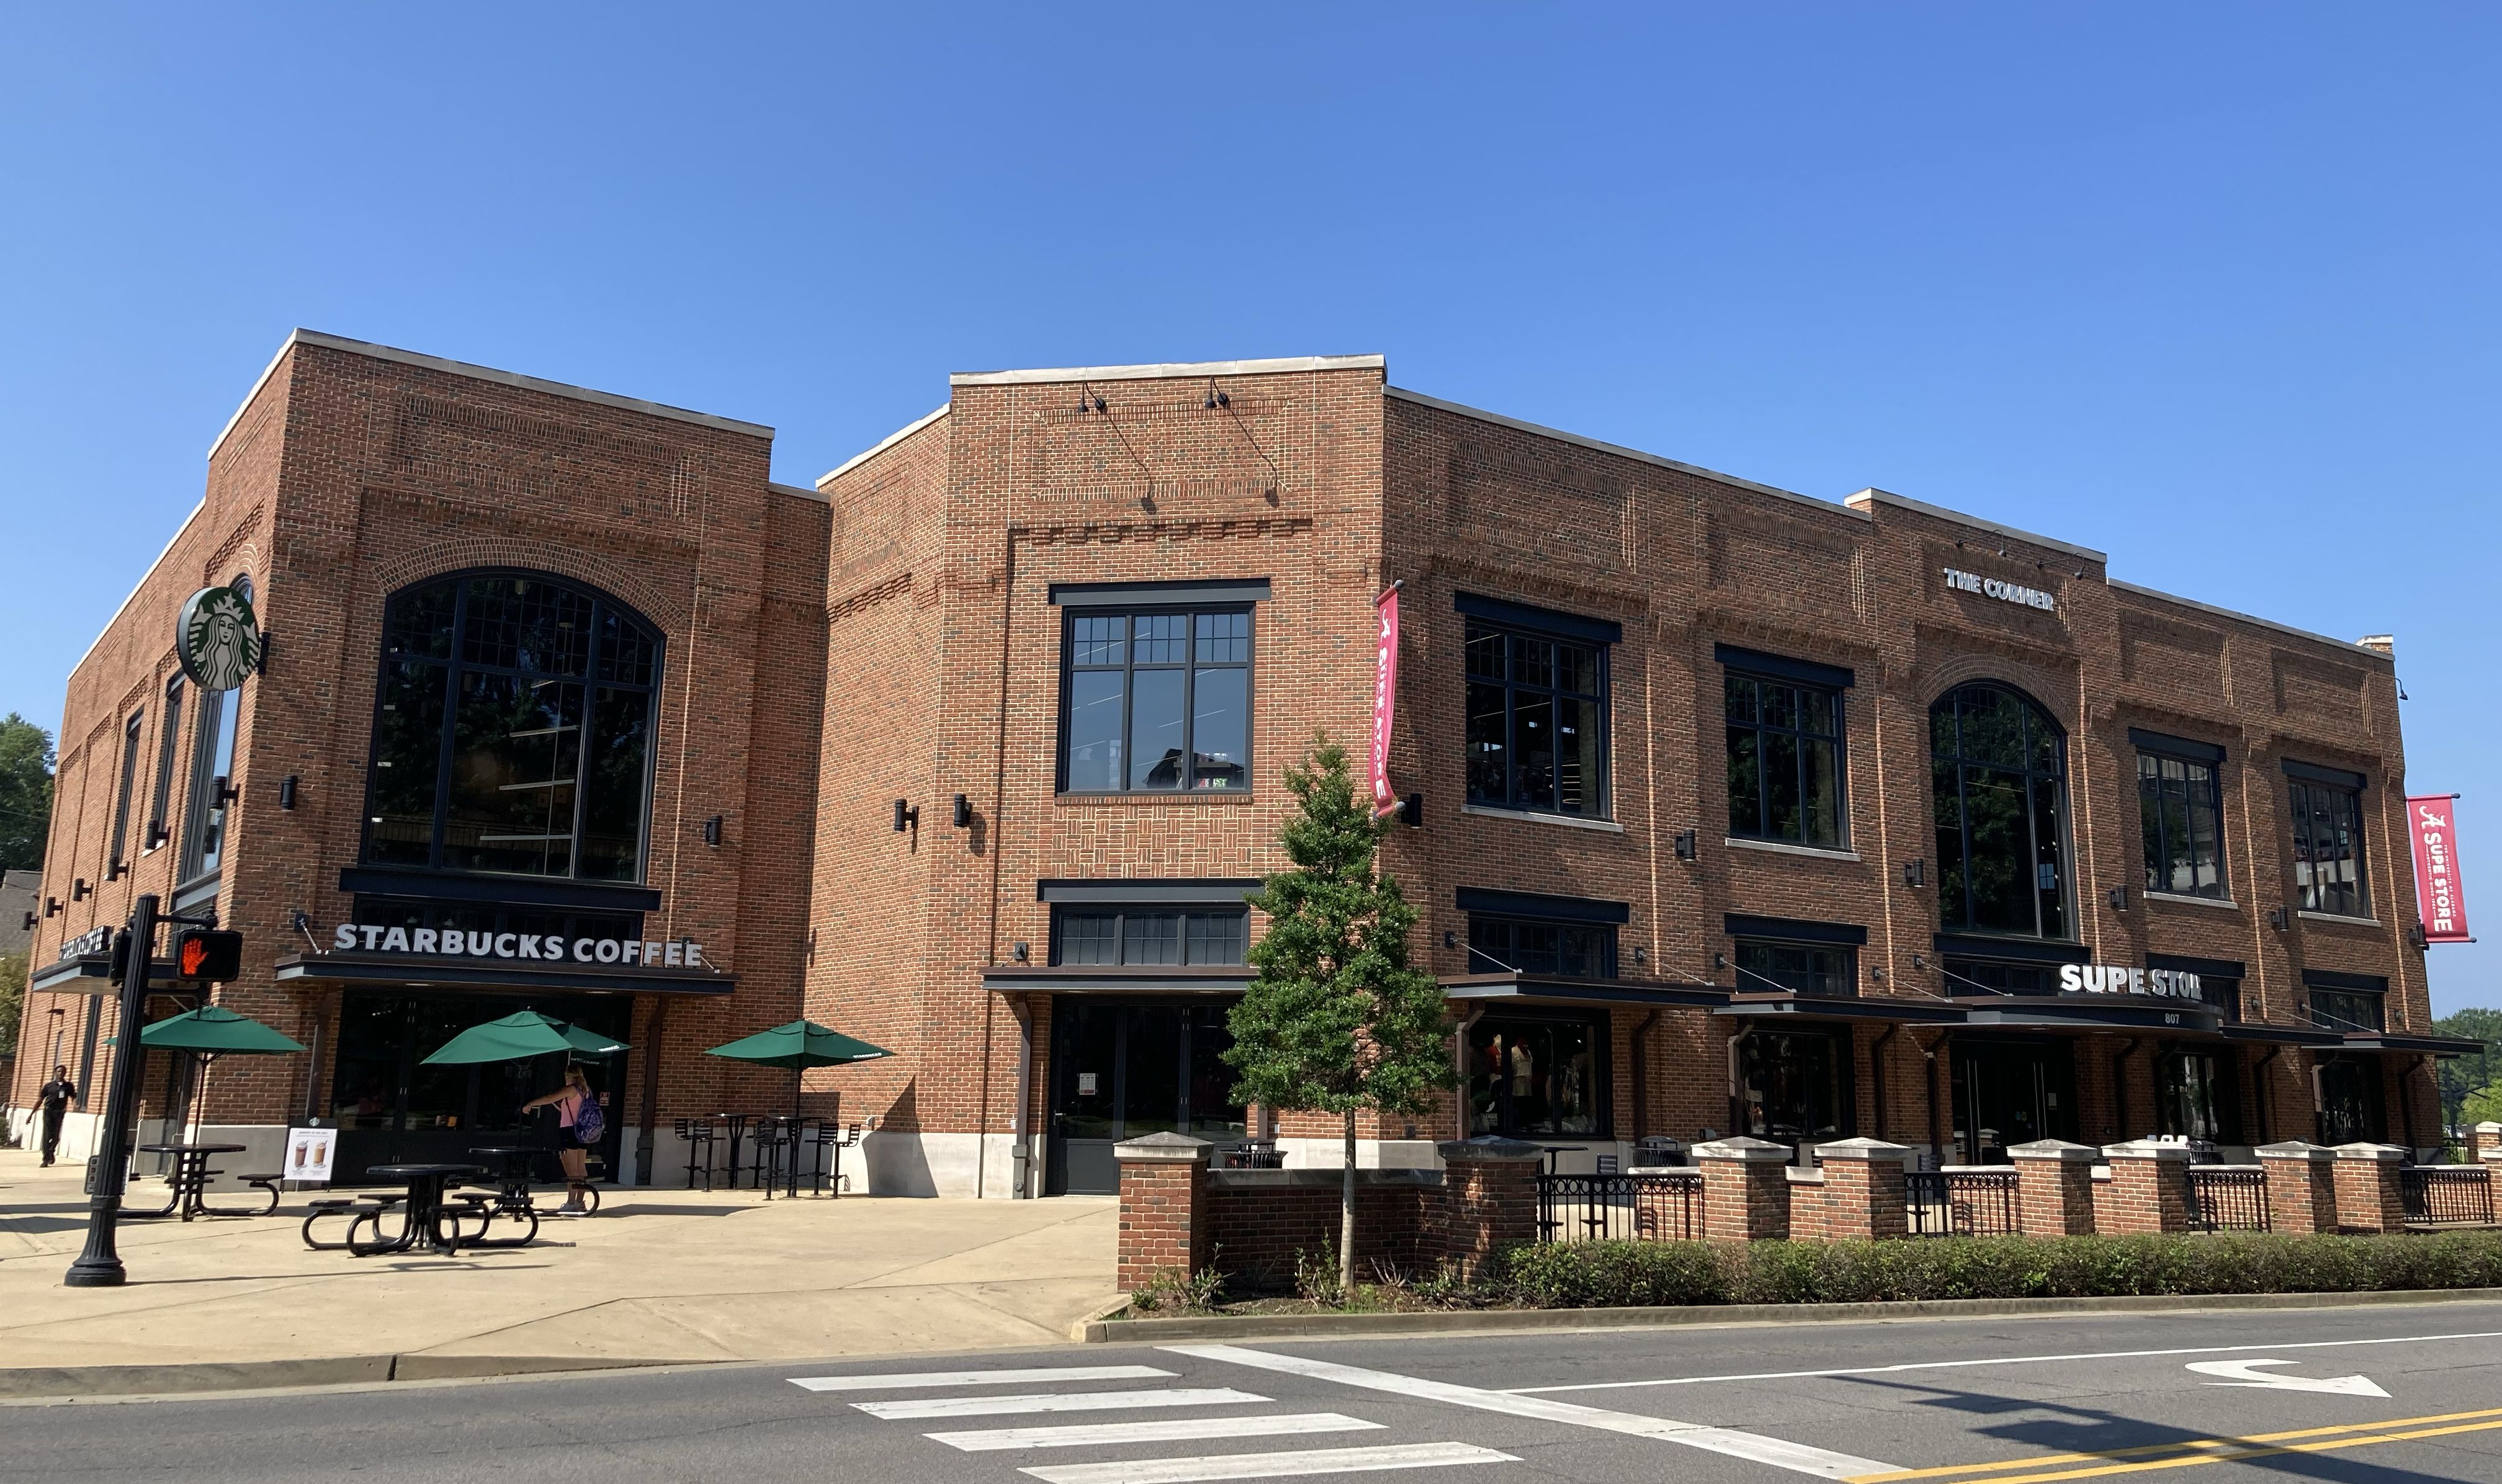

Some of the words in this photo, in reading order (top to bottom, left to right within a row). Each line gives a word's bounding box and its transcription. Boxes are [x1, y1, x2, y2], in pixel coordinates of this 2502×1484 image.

[1944, 568, 1981, 594] THE
[1984, 578, 2054, 611] CORNER
[2424, 833, 2446, 874] SUPE
[2434, 878, 2453, 932] STORE
[334, 923, 564, 960] STARBUCKS
[573, 937, 703, 967] COFFEE
[2060, 963, 2145, 993] SUPE
[2165, 1012, 2180, 1024] 807
